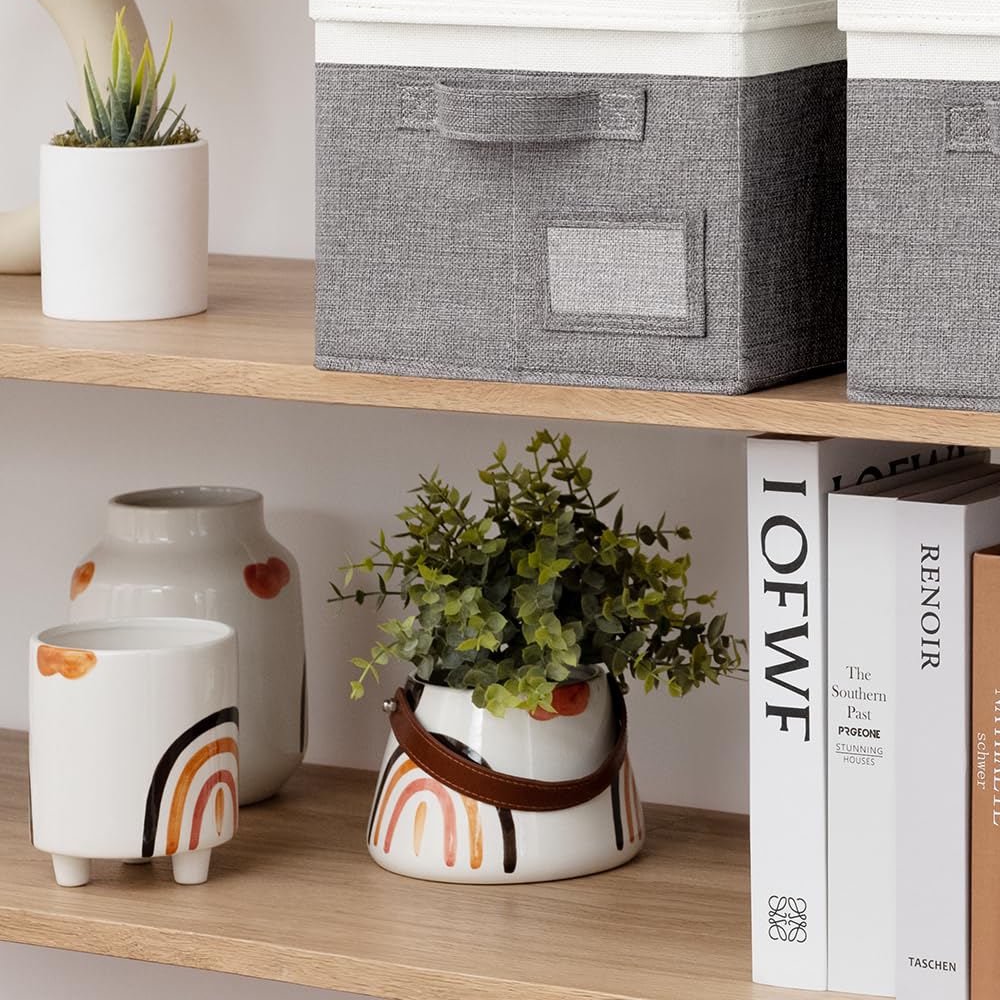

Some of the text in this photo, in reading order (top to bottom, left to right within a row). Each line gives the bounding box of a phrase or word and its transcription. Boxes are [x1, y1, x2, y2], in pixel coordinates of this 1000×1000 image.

[920, 543, 941, 670] RENOIR
[845, 665, 872, 681] The
[831, 684, 887, 702] Southern
[847, 705, 872, 721] Past
[835, 742, 884, 755] STUNNING
[843, 755, 876, 766] HOUSES
[976, 732, 989, 790] schwer
[908, 956, 957, 973] TASCHEN
